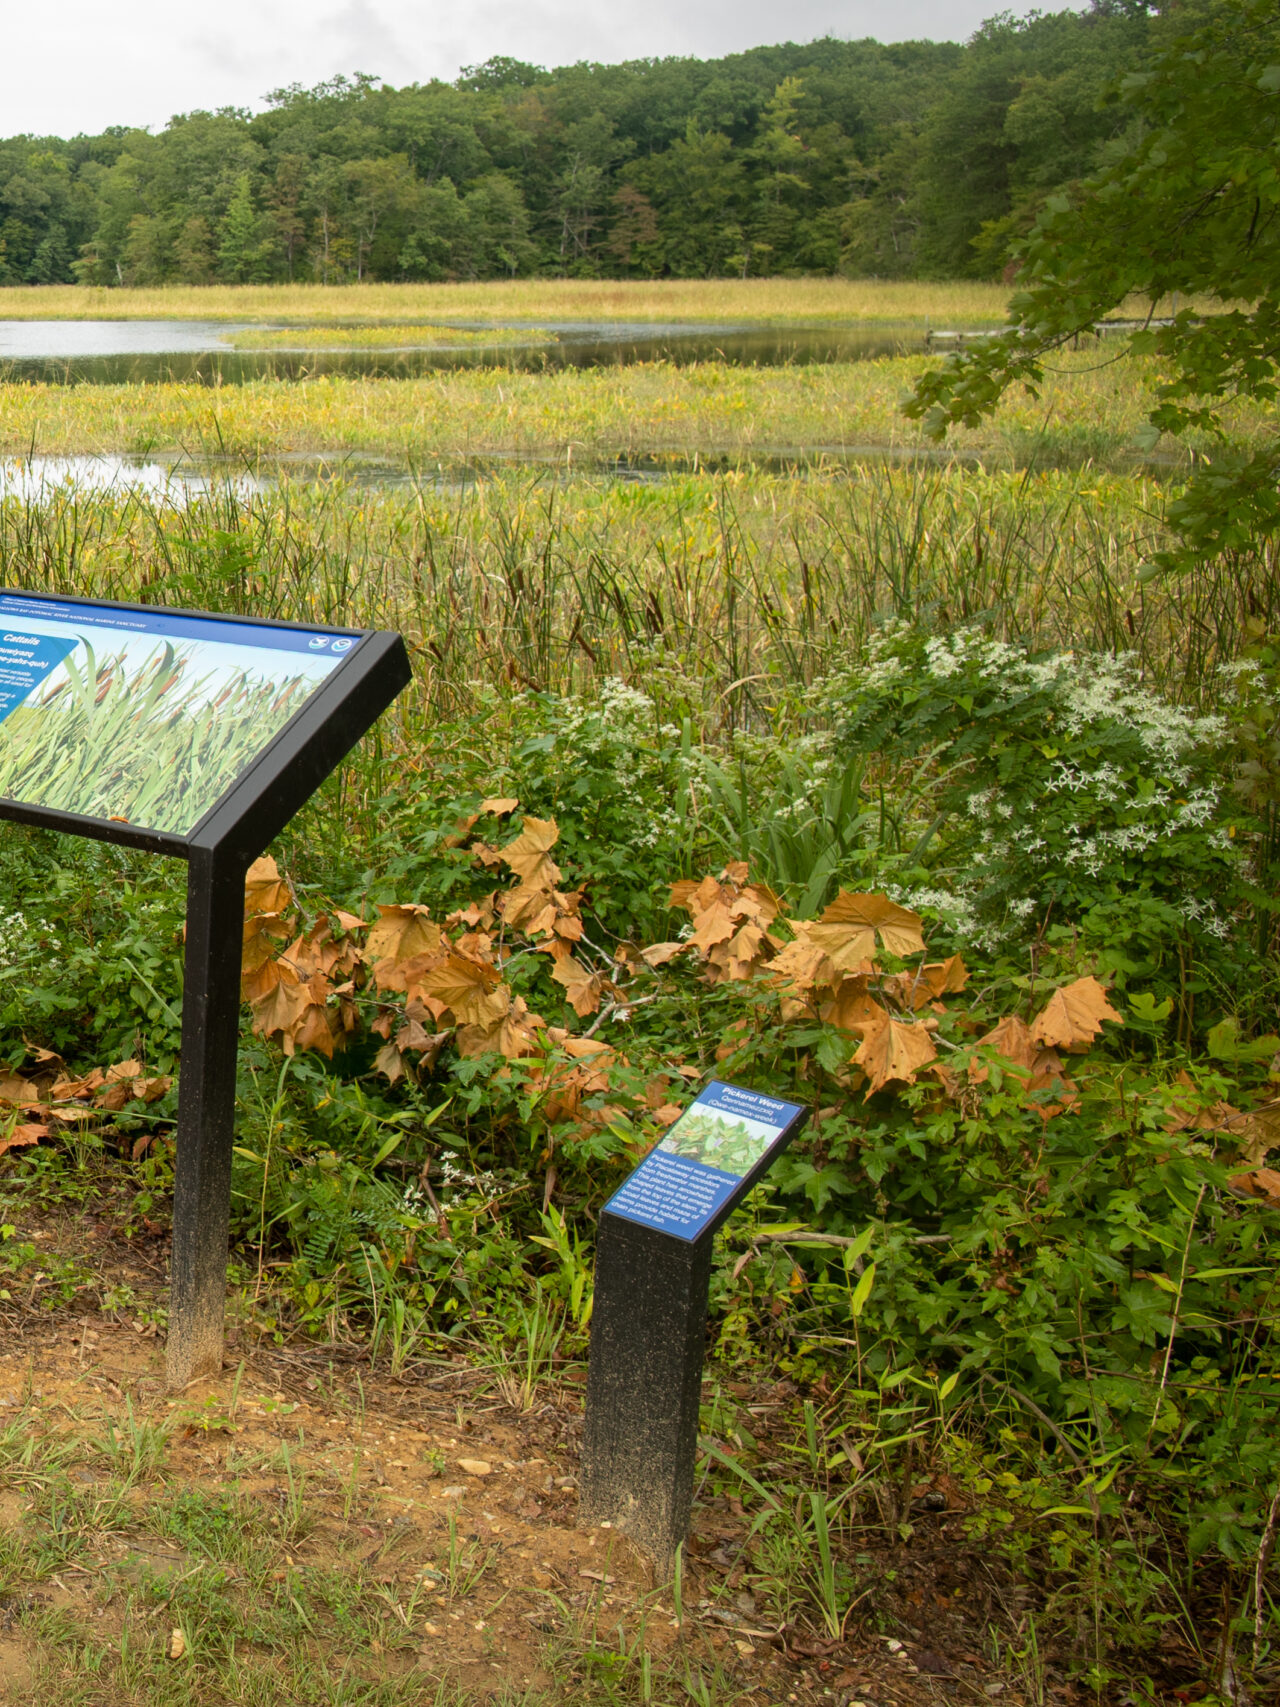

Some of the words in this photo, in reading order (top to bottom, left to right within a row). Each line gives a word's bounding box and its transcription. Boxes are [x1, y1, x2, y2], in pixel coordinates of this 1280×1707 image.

[3, 634, 40, 645] Cattails
[722, 1087, 758, 1100] Pickerel
[759, 1098, 784, 1110] Weed
[637, 1171, 650, 1180] This
[649, 1177, 666, 1185] plant
[641, 1166, 656, 1174] from
[656, 1171, 688, 1185] freshwater
[651, 1154, 676, 1166] Pickerel
[676, 1164, 694, 1172] weed
[706, 1174, 736, 1186] gathered
[655, 1163, 689, 1178] Piscataway
[689, 1176, 720, 1188] ancestors
[621, 1189, 640, 1199] broad
[640, 1196, 660, 1206] leaves
[631, 1178, 655, 1189] shaped
[654, 1186, 675, 1196] leaves
[688, 1198, 712, 1209] emerge
[611, 1202, 628, 1210] chain
[627, 1208, 653, 1219] pickerel
[616, 1196, 635, 1205] stems
[634, 1202, 658, 1213] provide
[658, 1210, 680, 1221] habitat
